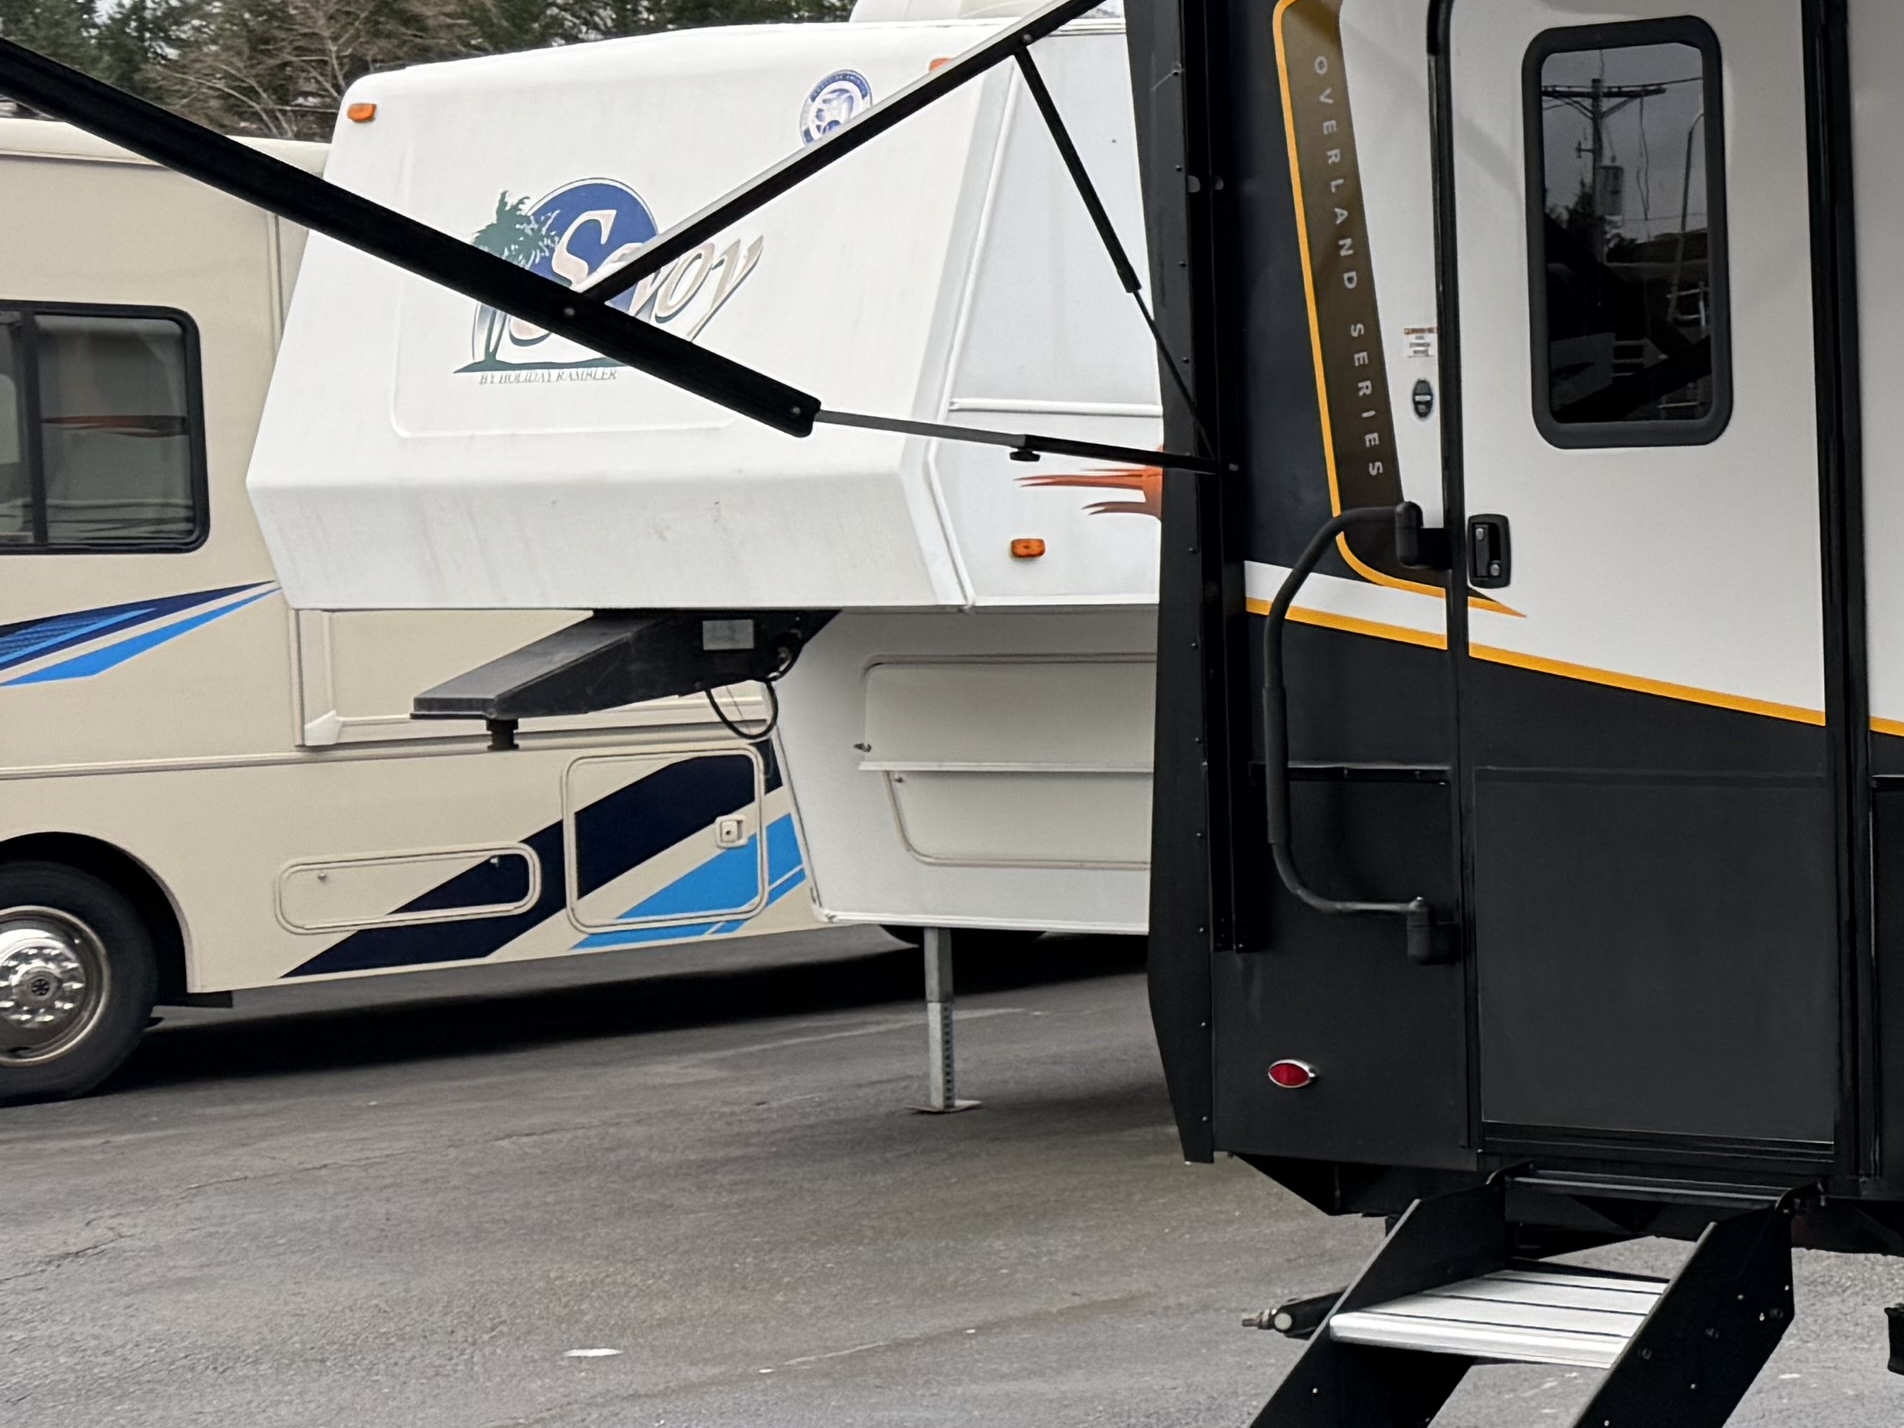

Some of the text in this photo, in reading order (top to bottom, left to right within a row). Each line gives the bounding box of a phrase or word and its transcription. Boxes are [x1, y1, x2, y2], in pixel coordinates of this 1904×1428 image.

[1314, 55, 1384, 477] OVERLAND SERIES
[479, 368, 618, 385] BY HOLIDAY RAMBLER
